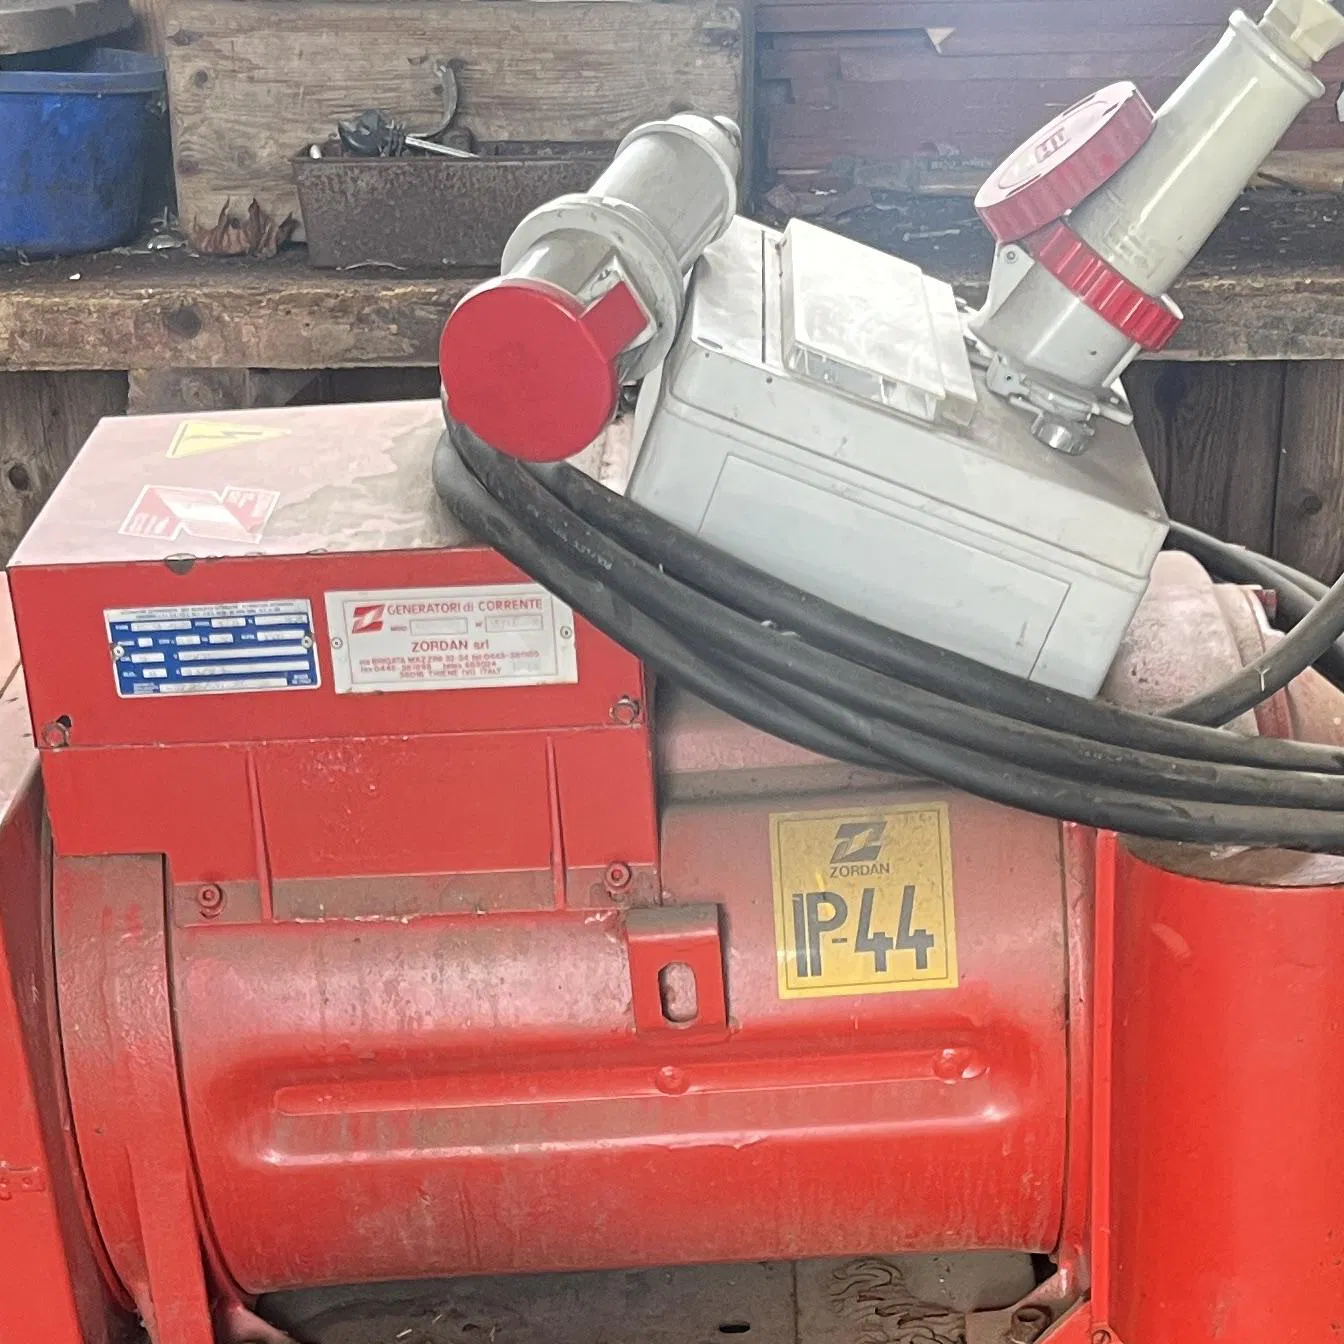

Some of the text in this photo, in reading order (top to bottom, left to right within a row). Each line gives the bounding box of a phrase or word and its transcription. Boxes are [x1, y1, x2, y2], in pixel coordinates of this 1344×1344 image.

[387, 602, 461, 616] GENERATORI
[463, 601, 474, 612] di
[479, 599, 543, 611] CORRENTE
[411, 638, 490, 653] ZORDAN srl
[829, 863, 891, 879] ZORDAN
[791, 884, 935, 978] IP-44
